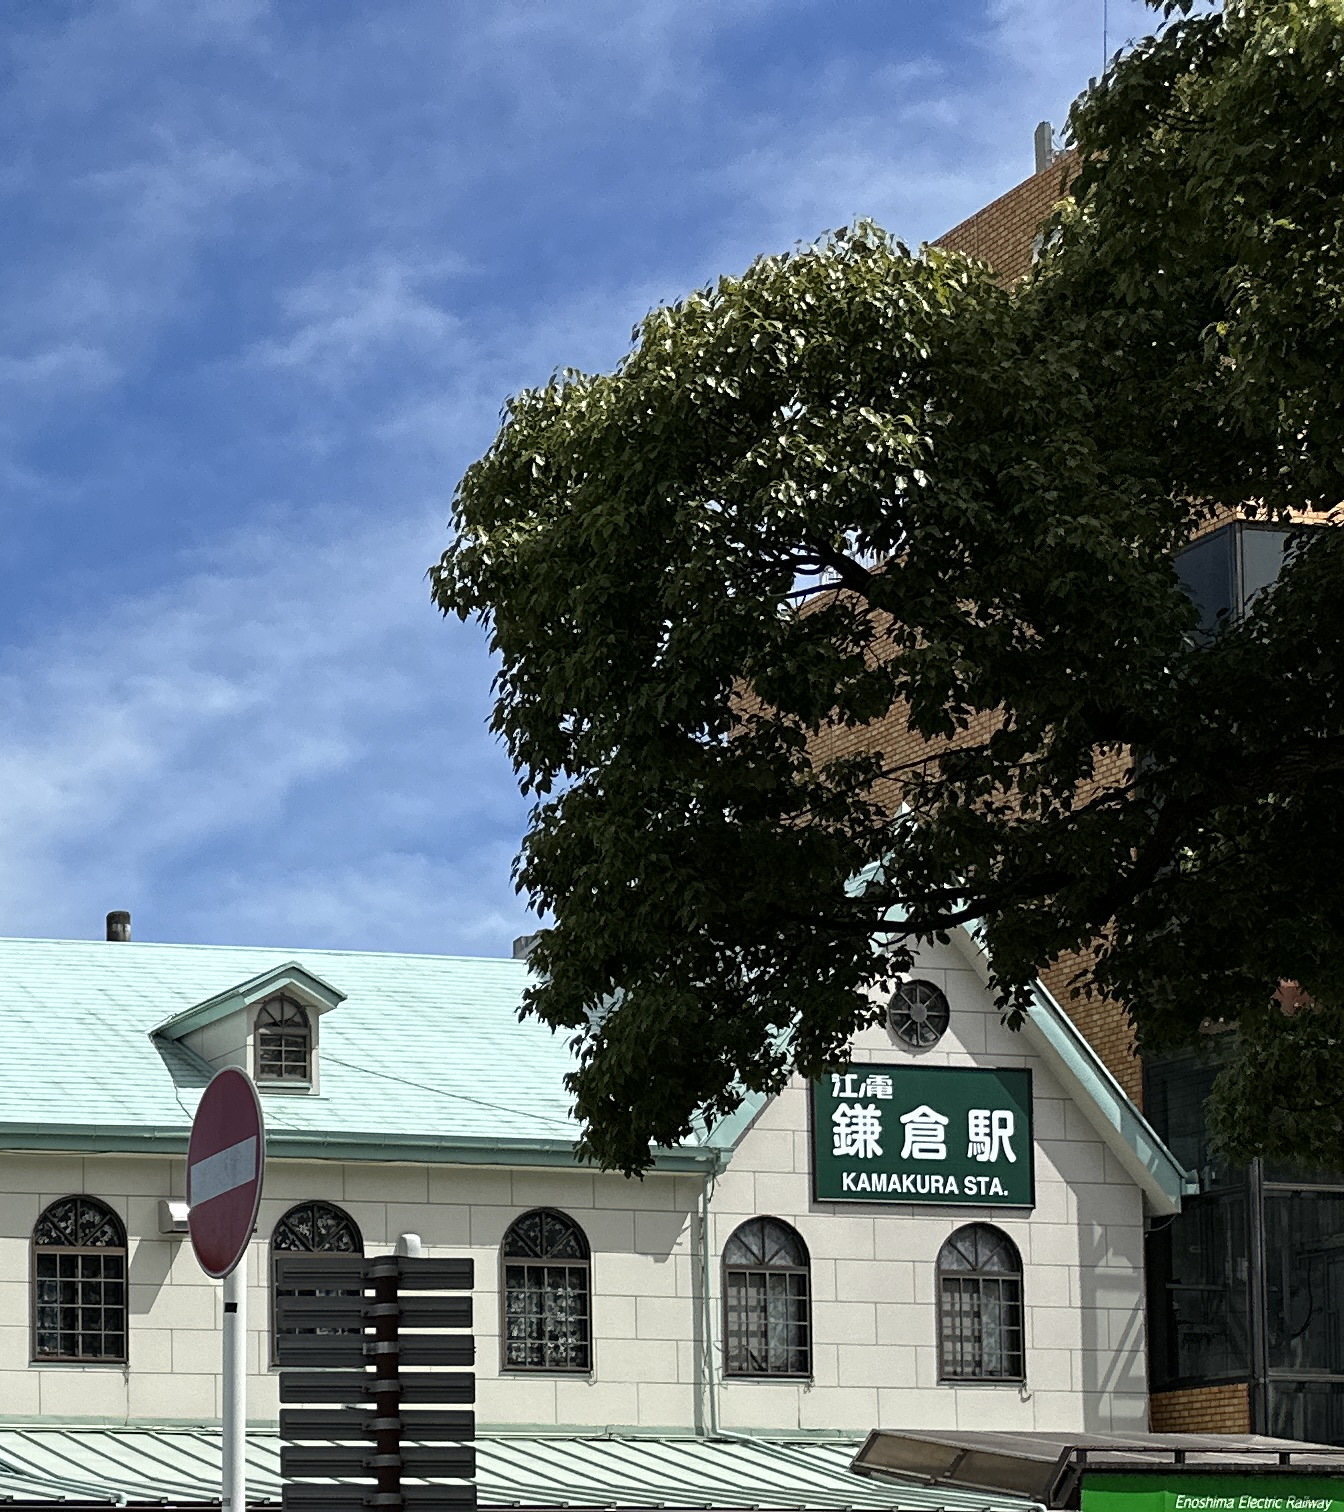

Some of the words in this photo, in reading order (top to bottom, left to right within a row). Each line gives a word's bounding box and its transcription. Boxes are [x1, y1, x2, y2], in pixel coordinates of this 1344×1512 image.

[831, 1073, 893, 1099] 江ノ電
[831, 1102, 1017, 1163] 鎌倉駅
[842, 1172, 959, 1195] KAMAKURA
[963, 1175, 1009, 1196] STA.
[1176, 1495, 1234, 1509] Enoshima
[1238, 1495, 1283, 1509] Electric
[1285, 1496, 1333, 1511] Railway
